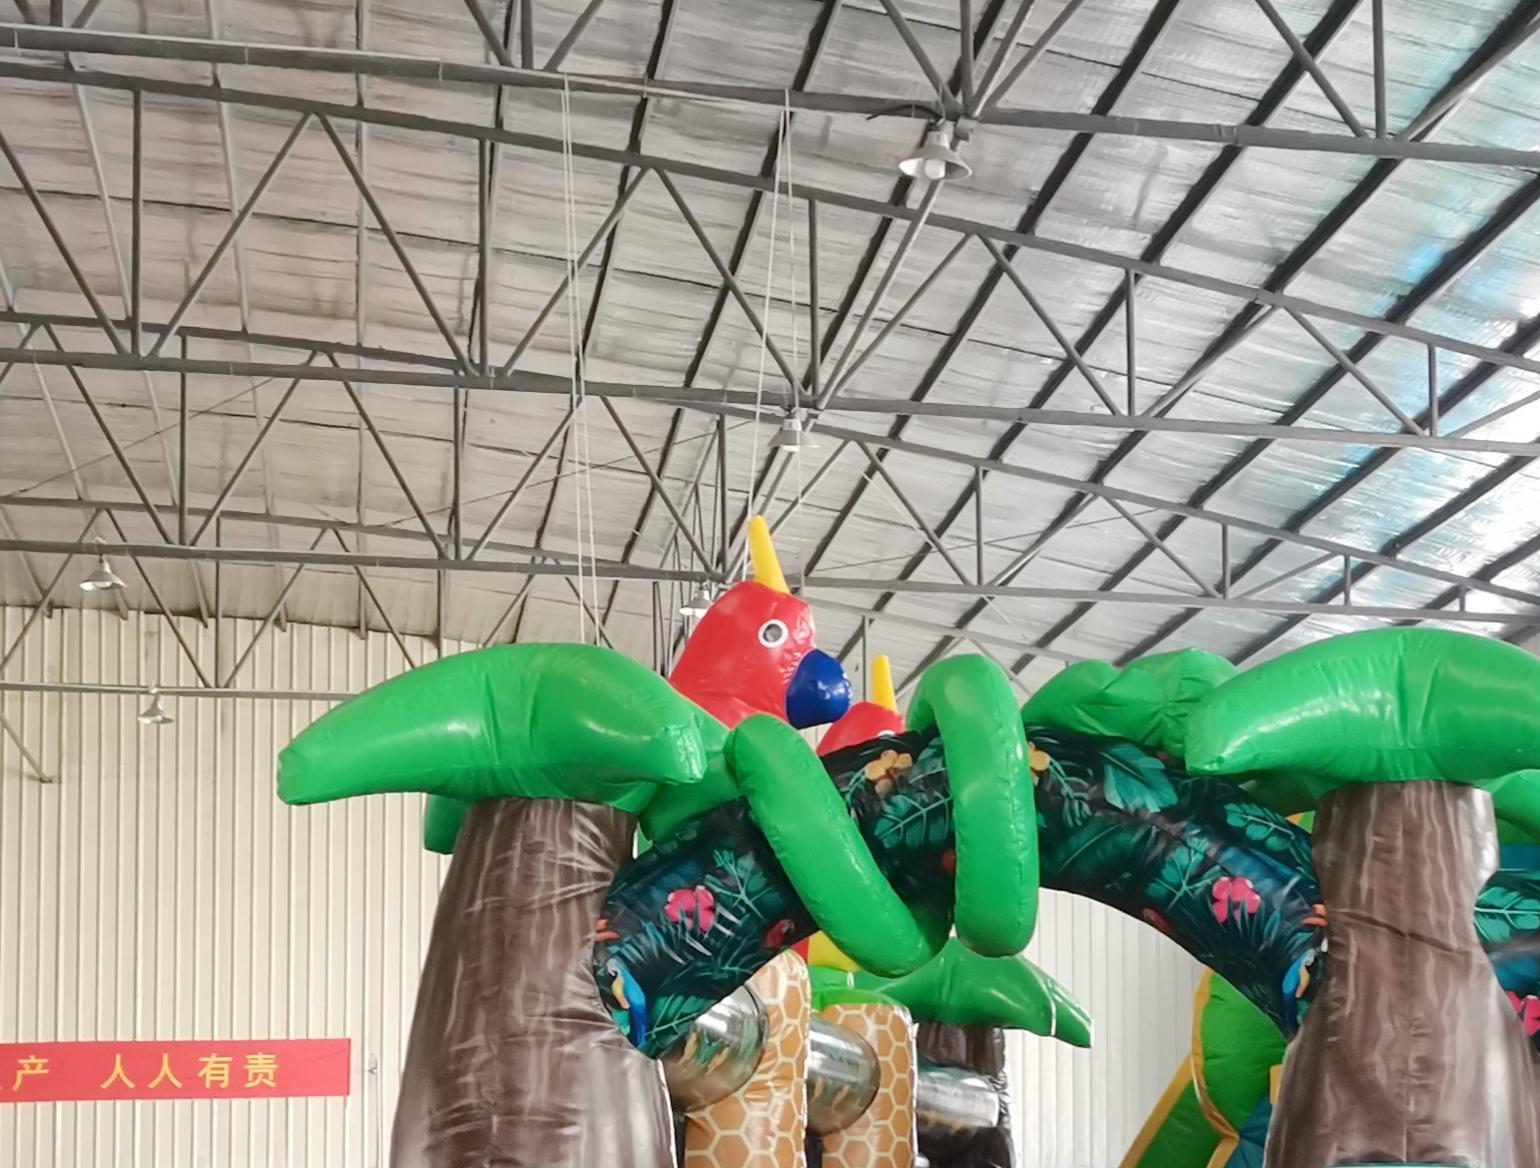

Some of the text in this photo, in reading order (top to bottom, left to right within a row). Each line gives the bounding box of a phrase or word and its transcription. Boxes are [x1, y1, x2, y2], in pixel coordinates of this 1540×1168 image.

[0, 1052, 279, 1091] 产 人人有责
